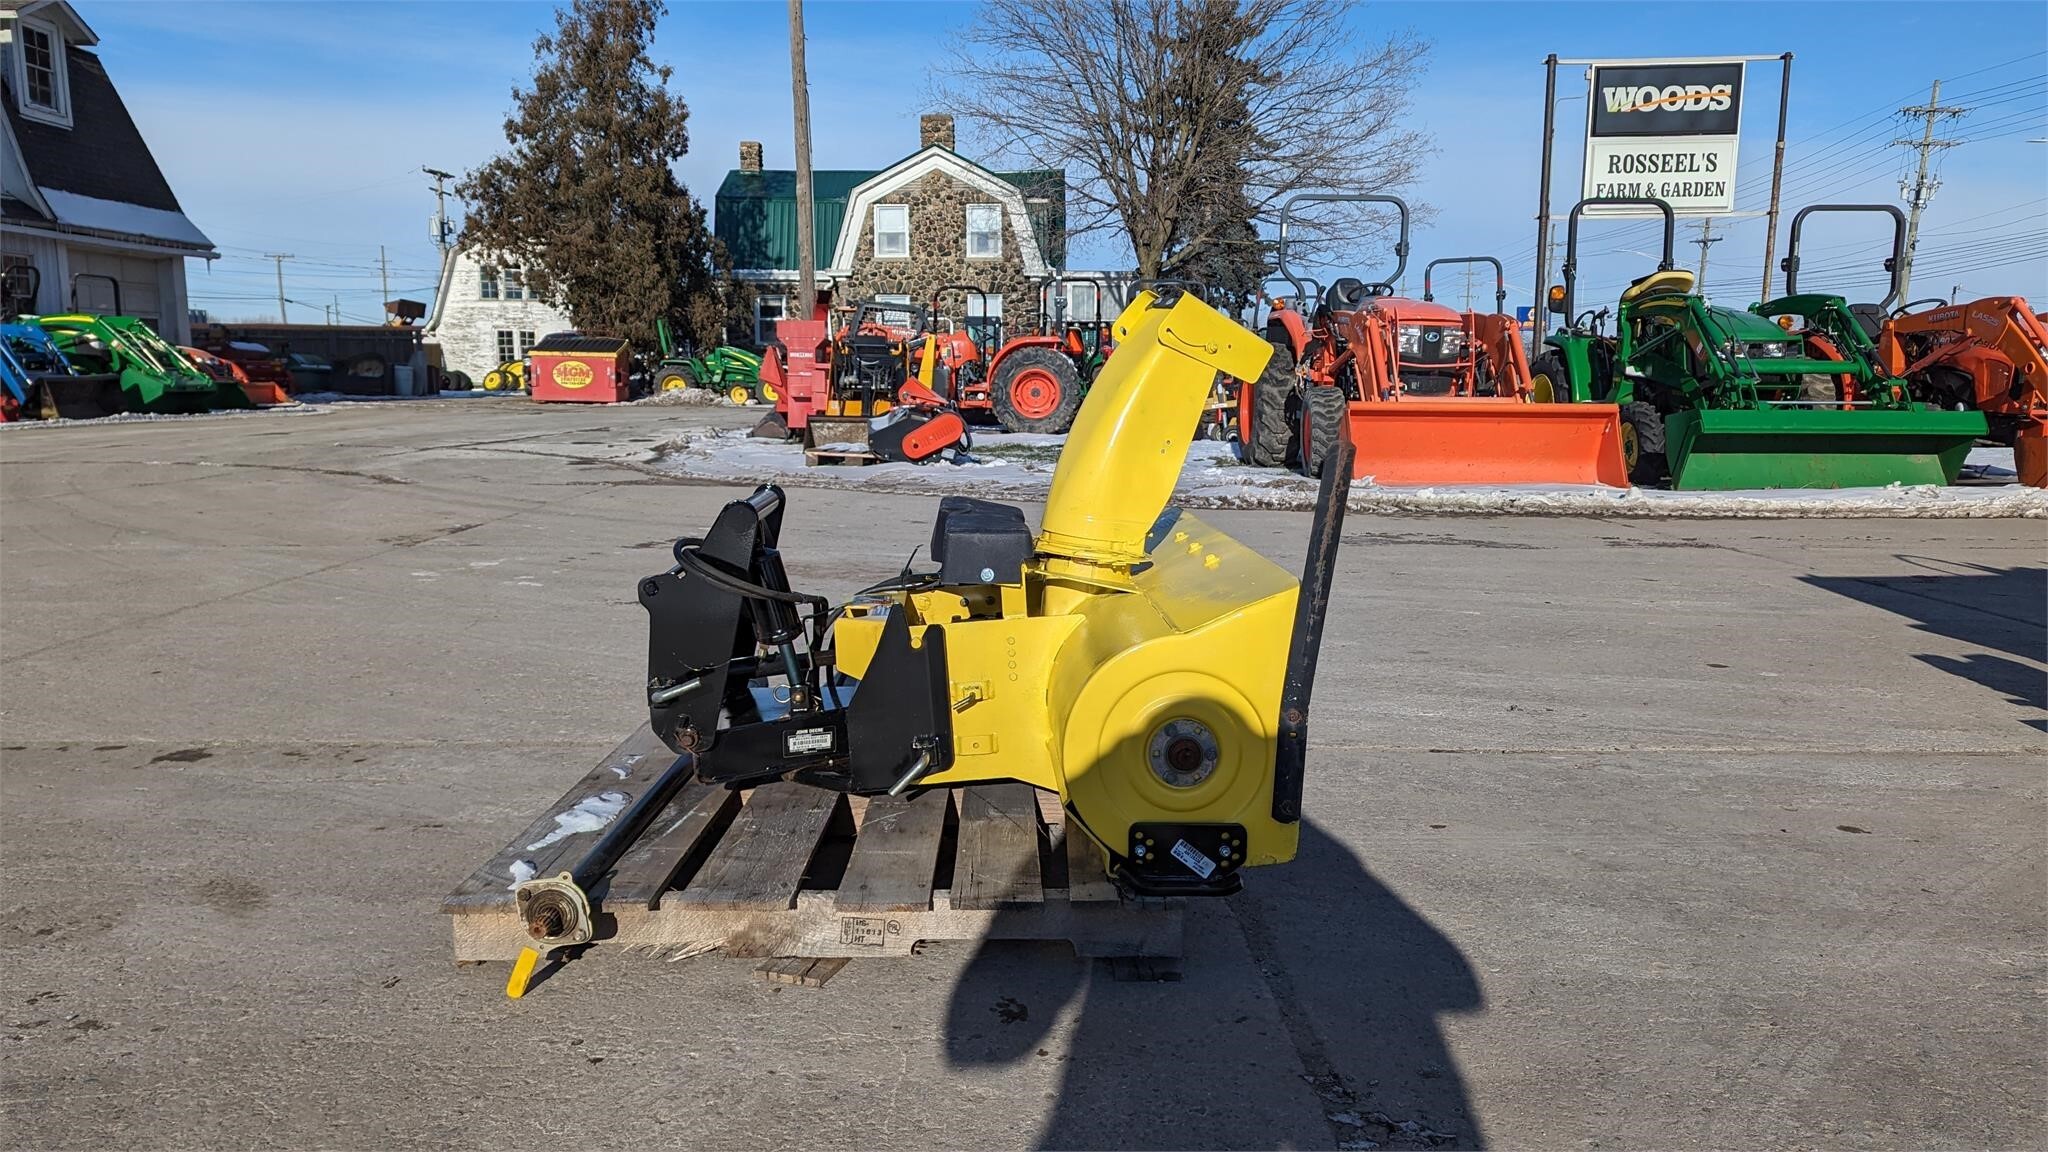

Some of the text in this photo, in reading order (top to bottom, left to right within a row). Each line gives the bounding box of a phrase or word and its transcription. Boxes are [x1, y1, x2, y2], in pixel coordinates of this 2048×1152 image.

[1603, 85, 1732, 112] WOODS
[1608, 153, 1718, 174] ROSSEEL'S
[1596, 181, 1726, 199] FARM & GARDEN
[1928, 310, 1960, 322] KUBOTA
